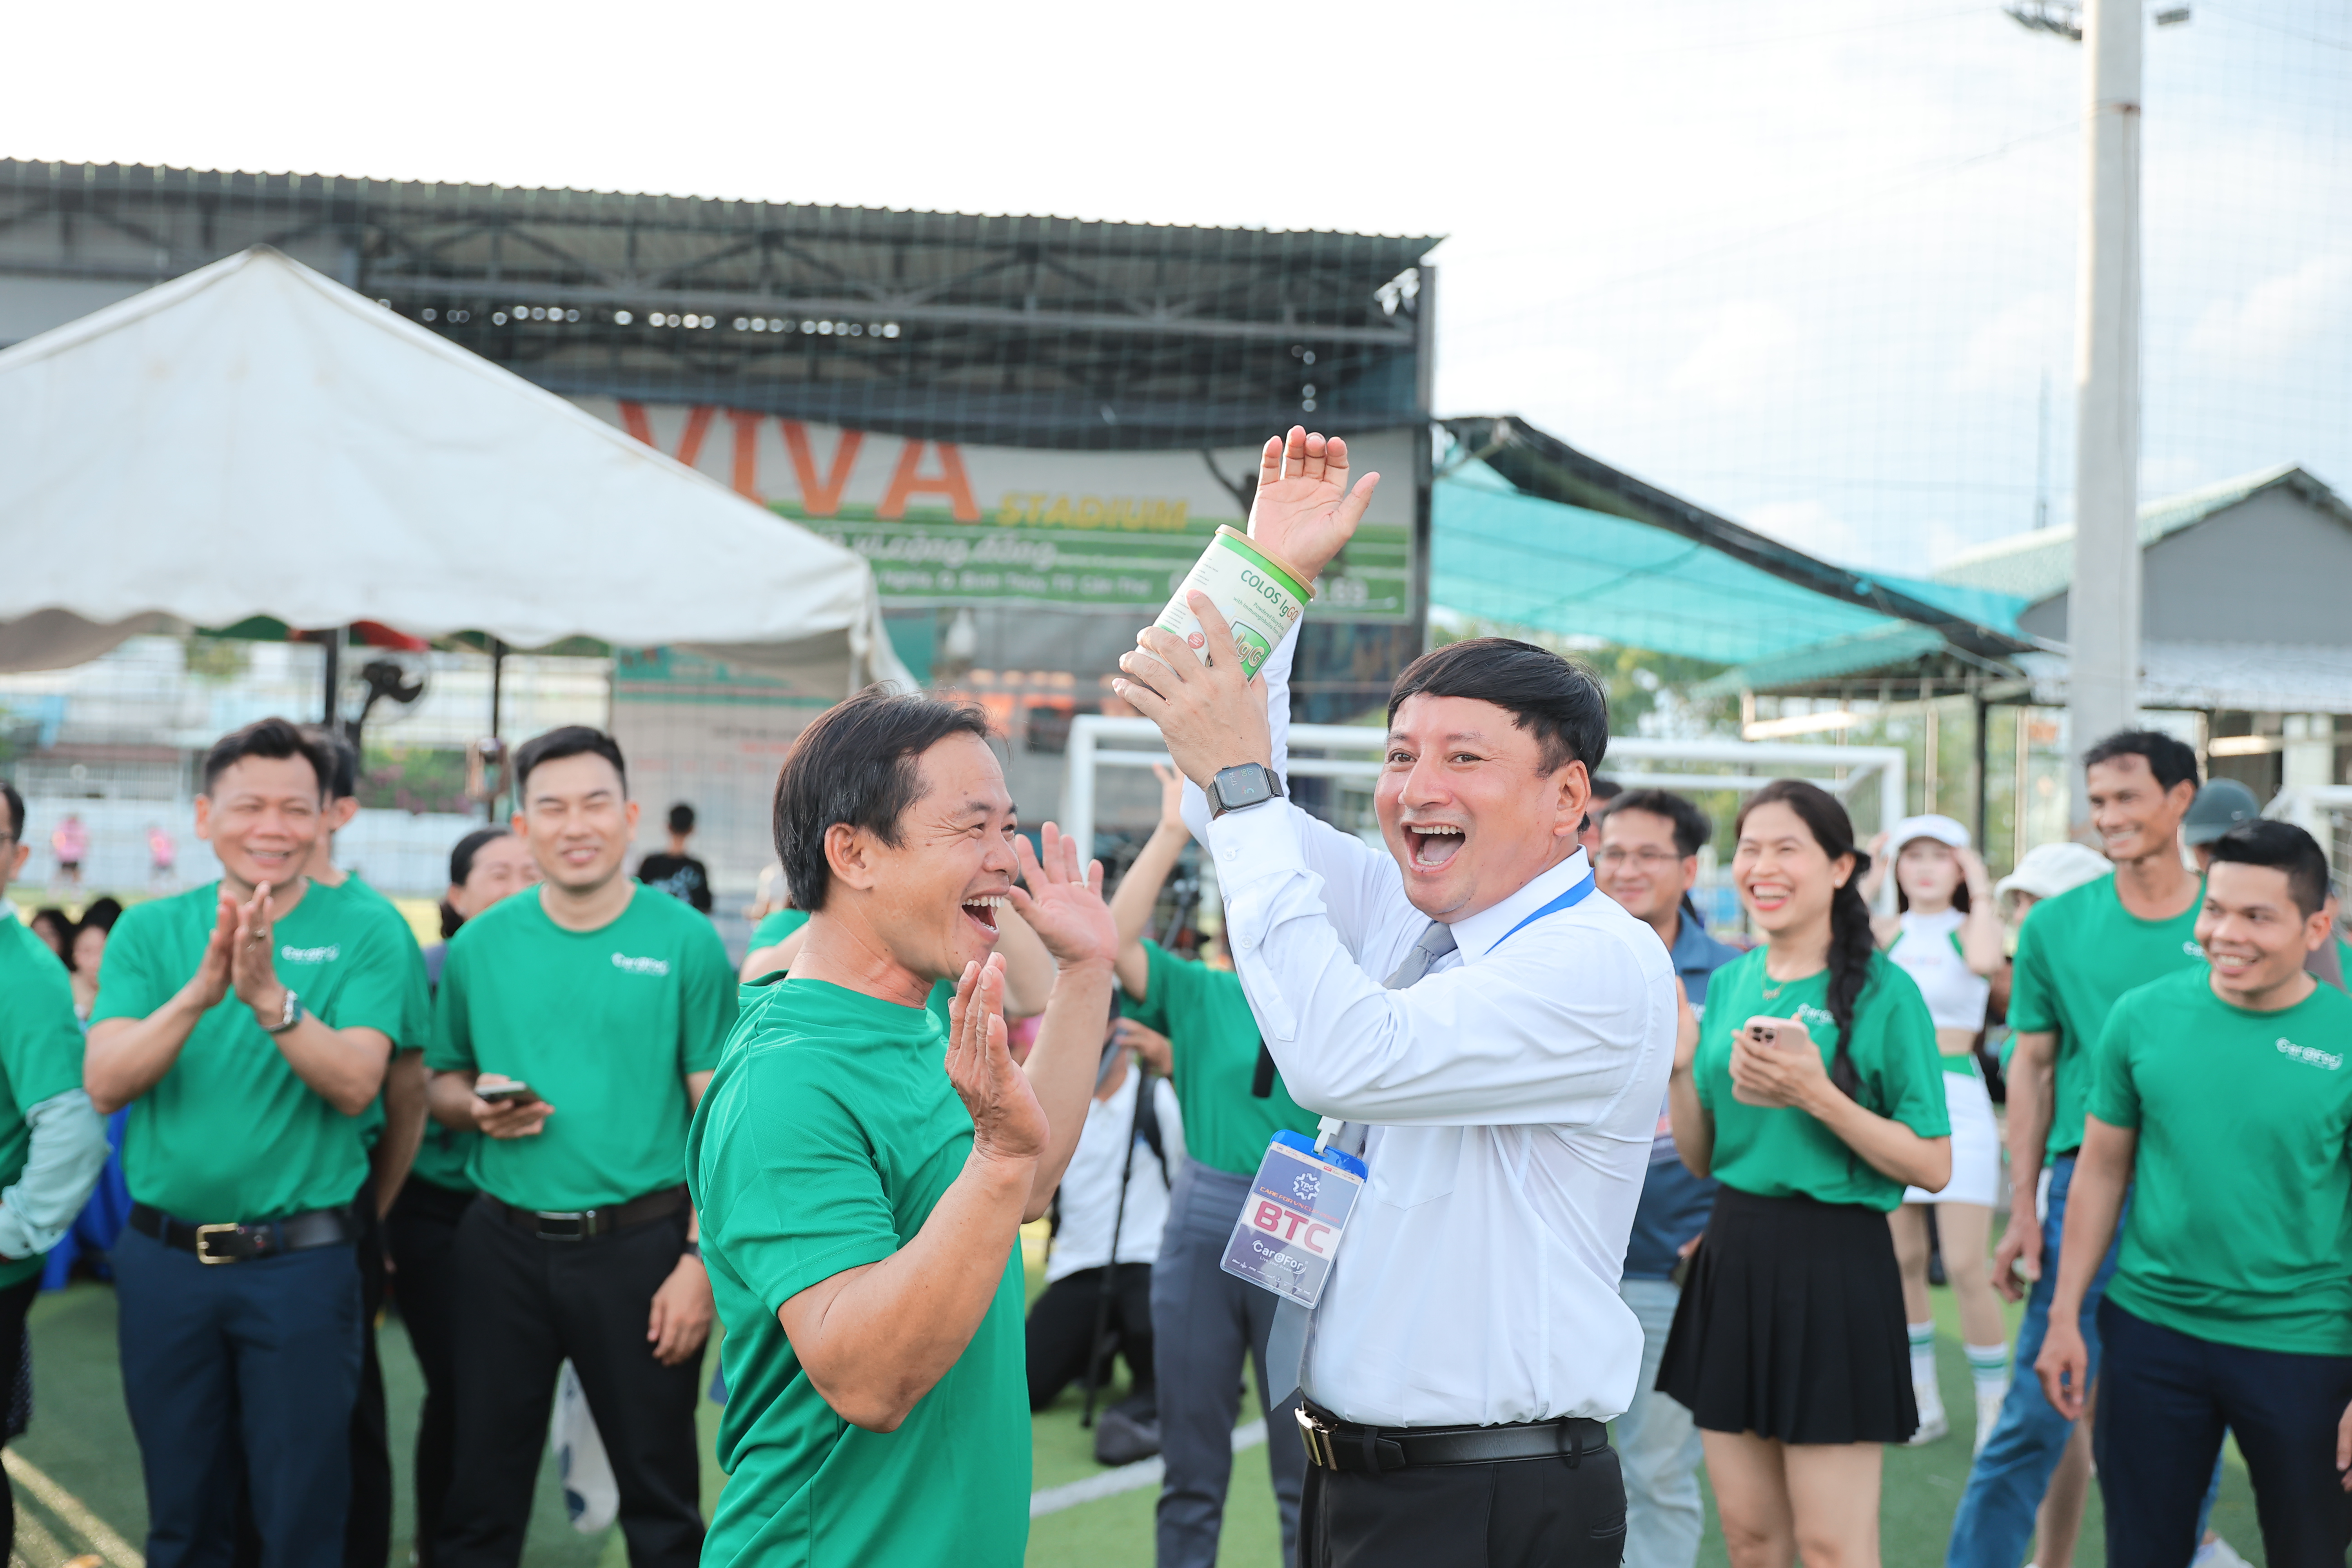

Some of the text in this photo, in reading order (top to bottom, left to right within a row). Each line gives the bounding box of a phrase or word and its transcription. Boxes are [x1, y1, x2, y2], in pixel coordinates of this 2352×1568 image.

[618, 399, 981, 522] VIVA
[996, 491, 1188, 531] STADIUM
[1241, 570, 1281, 604] COLOS
[1233, 597, 1243, 606] with
[1243, 603, 1273, 630] Immunoglobulins
[1253, 602, 1274, 619] Powdered
[1270, 617, 1279, 626] Dairy
[1234, 631, 1265, 668] IgG
[1229, 772, 1238, 786] 17:14
[1260, 1187, 1278, 1198] CARE
[1279, 1194, 1293, 1203] FOR
[1304, 1205, 1319, 1214] CUP
[1300, 1180, 1314, 1191] TPG
[1254, 1201, 1330, 1253] BTC
[1252, 1240, 1307, 1274] CareFor
